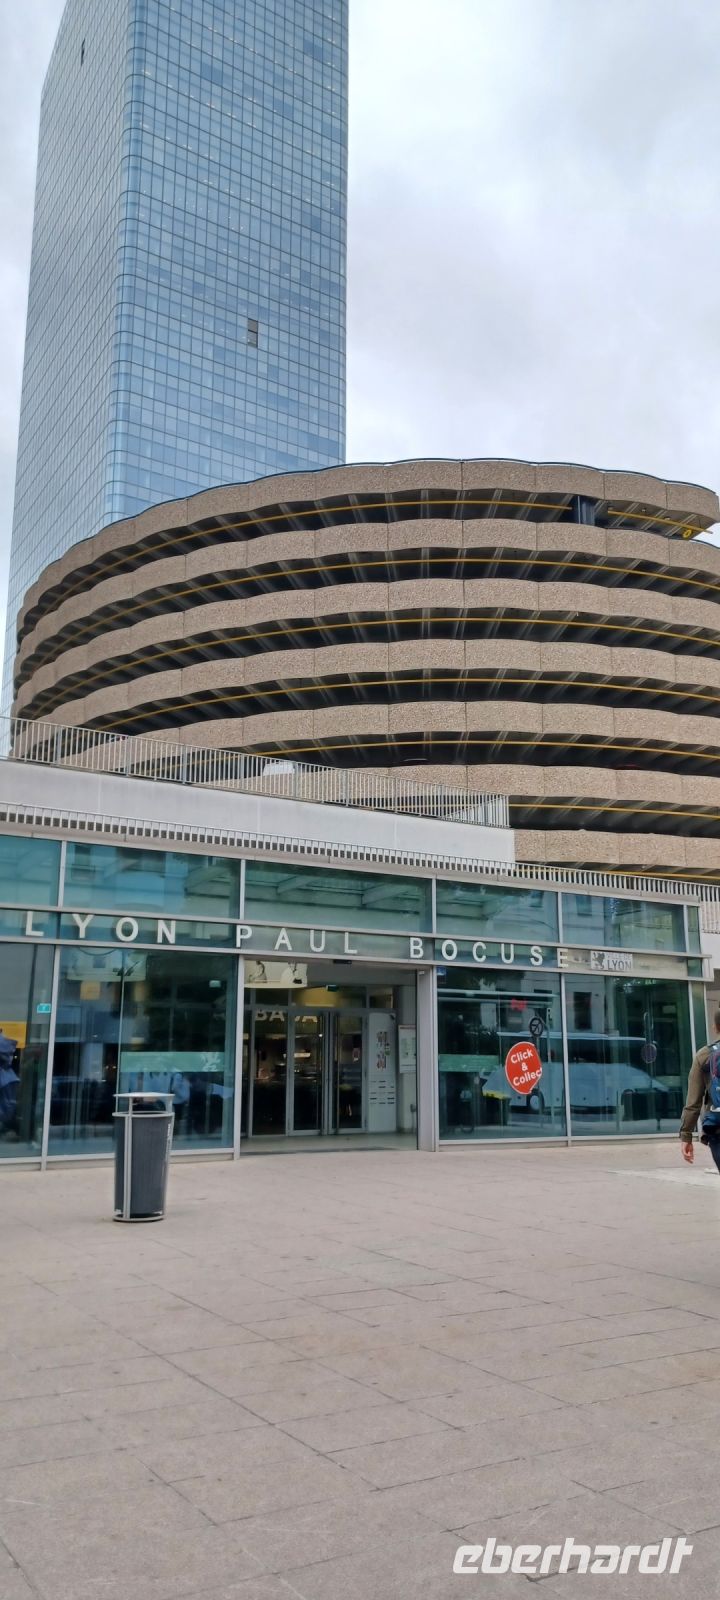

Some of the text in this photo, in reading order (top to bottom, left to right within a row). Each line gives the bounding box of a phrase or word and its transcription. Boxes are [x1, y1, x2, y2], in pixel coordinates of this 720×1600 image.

[25, 910, 569, 967] LYON PAUL BOCUSE
[607, 959, 632, 971] LYON
[511, 1048, 534, 1064] Click
[521, 1062, 528, 1071] &
